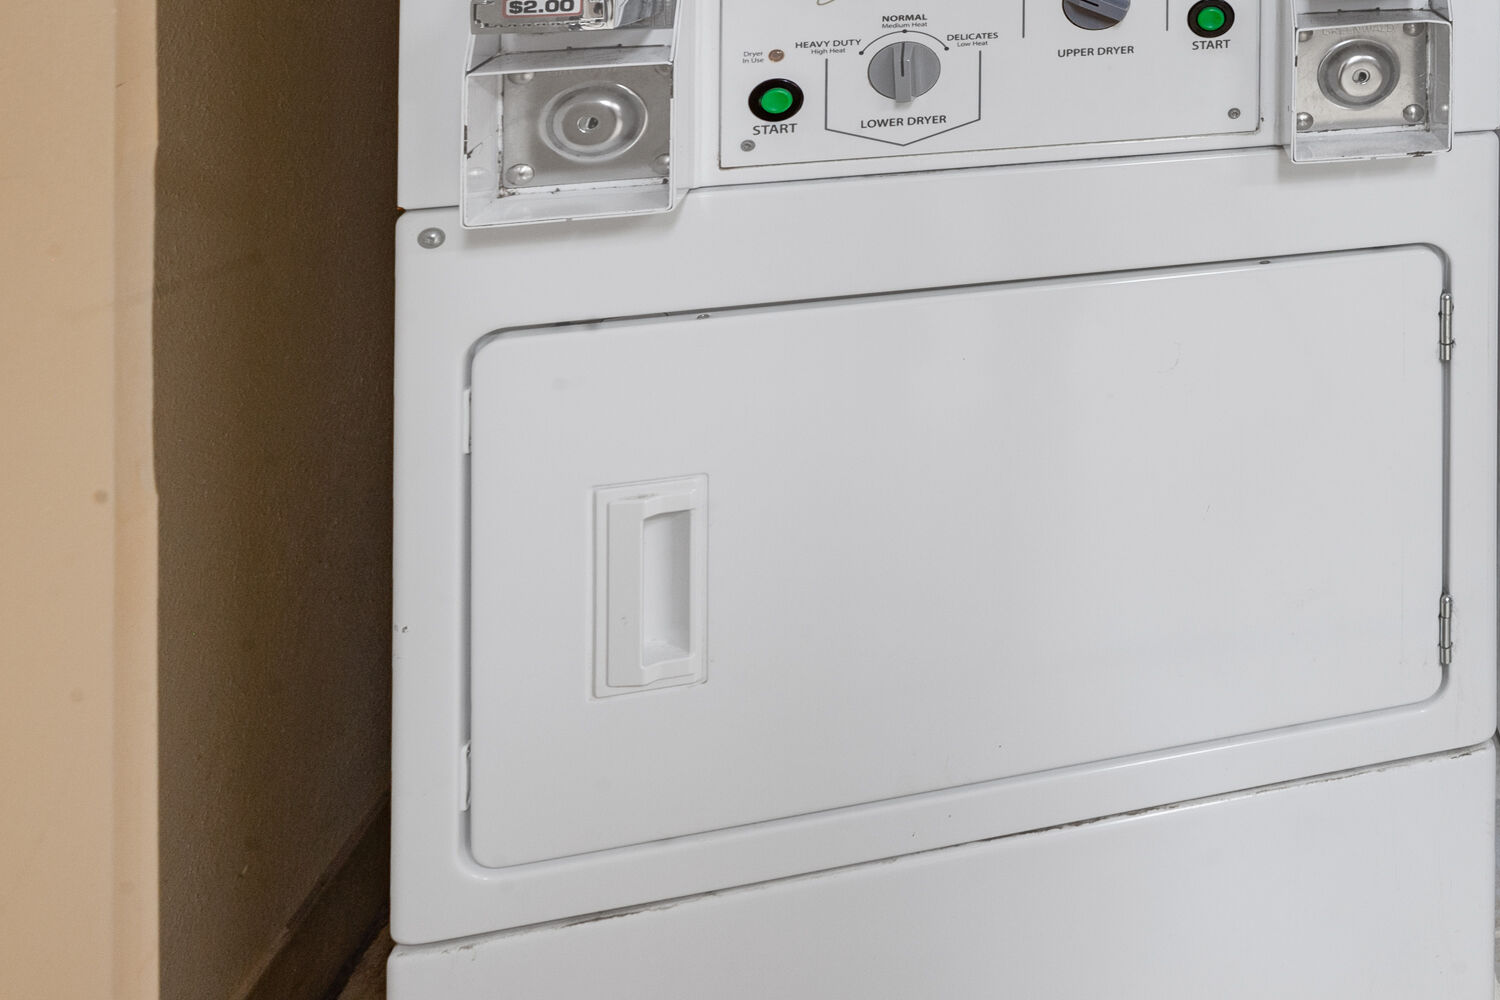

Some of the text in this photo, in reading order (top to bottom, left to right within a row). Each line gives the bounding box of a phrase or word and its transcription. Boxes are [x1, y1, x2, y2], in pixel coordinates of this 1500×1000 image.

[508, 0, 575, 14] $2.00
[882, 14, 928, 22] NORMAL
[946, 32, 999, 42] DELICATES
[796, 38, 862, 49] HEAVY DUTY
[1192, 39, 1231, 51] START
[744, 50, 763, 58] Dryer
[811, 48, 828, 56] High
[1058, 46, 1135, 58] UPPER DRYER
[861, 114, 947, 129] LOWER DRYER
[752, 123, 797, 136] START
